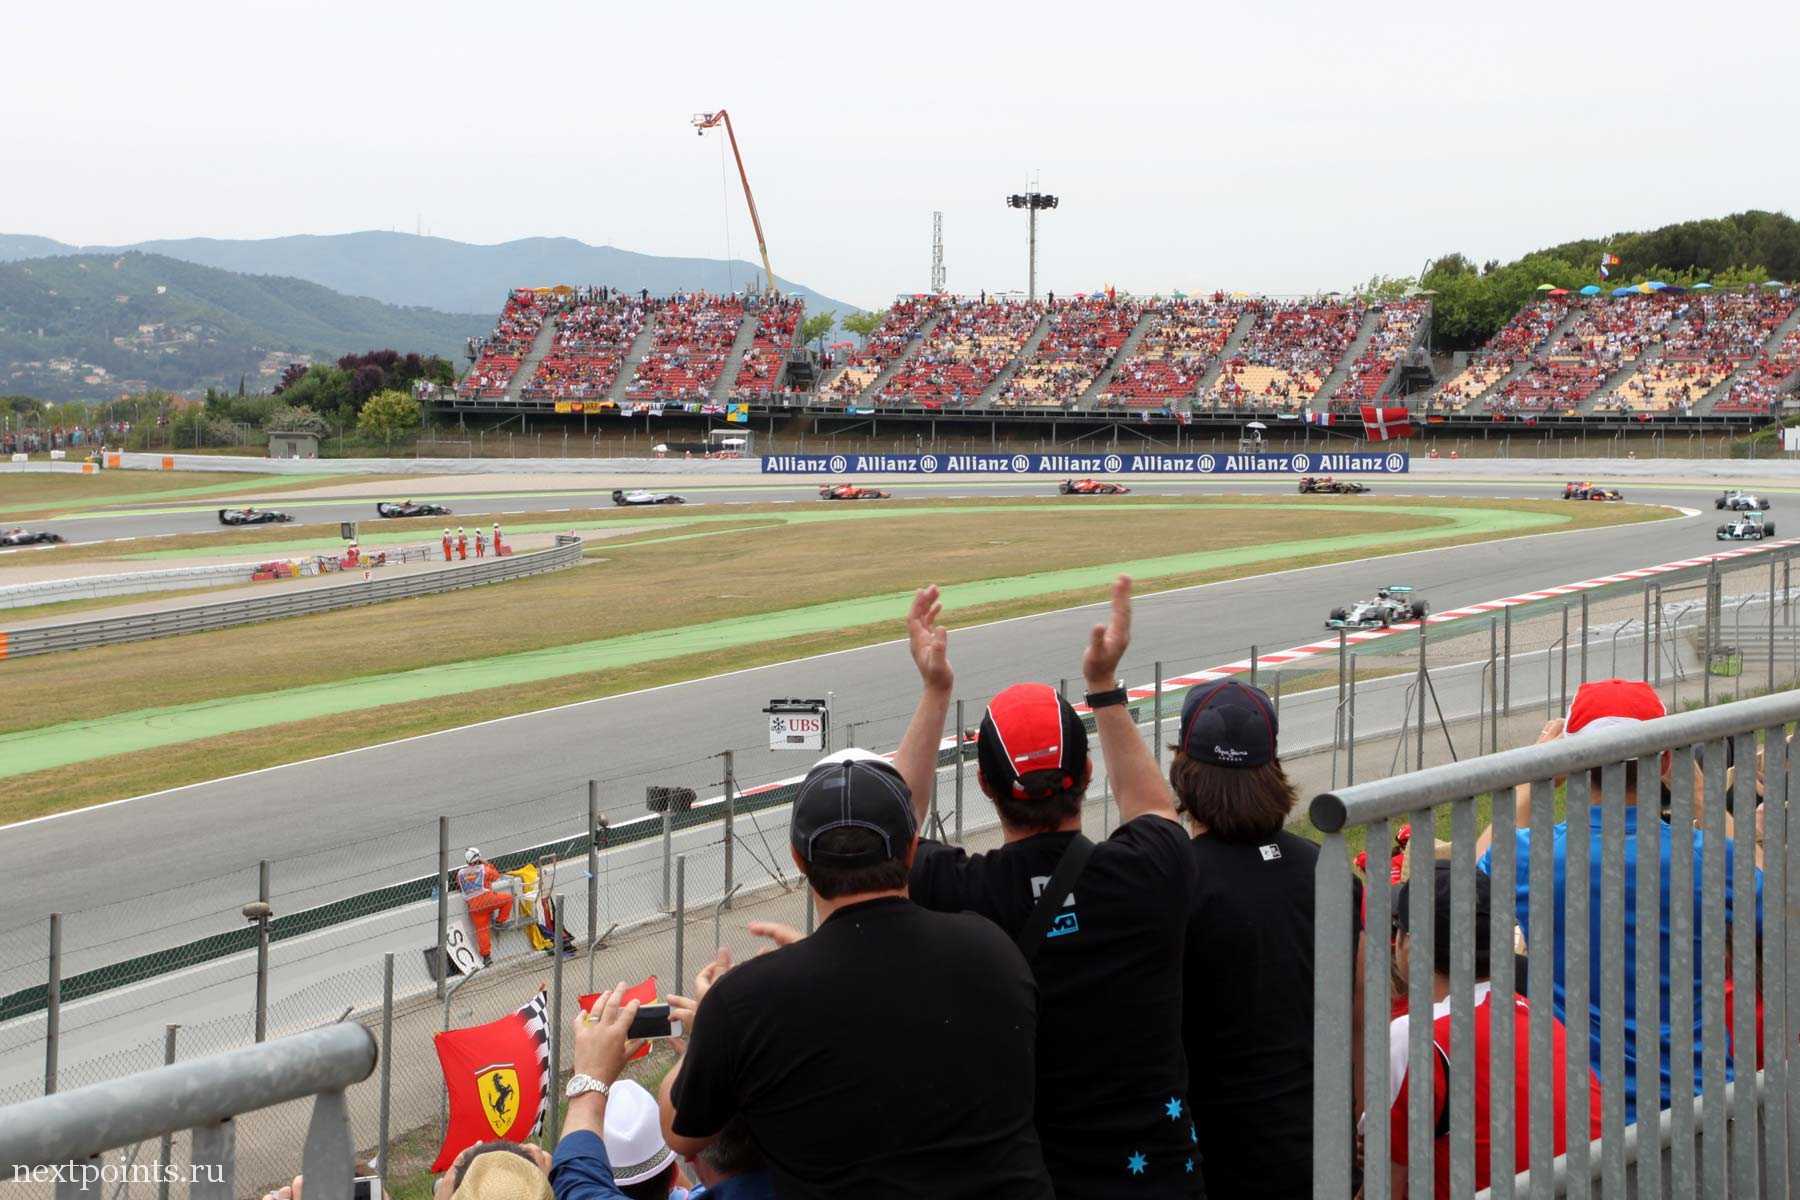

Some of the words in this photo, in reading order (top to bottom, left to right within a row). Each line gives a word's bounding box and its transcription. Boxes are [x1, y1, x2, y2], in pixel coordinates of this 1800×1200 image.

[766, 457, 826, 472] Allianz
[857, 457, 917, 472] Allianz
[947, 456, 1008, 472] Allianz
[1040, 456, 1101, 471] Allianz
[1132, 456, 1193, 471] Allianz
[1226, 456, 1288, 471] Allianz
[1320, 455, 1382, 470] Allianz
[789, 719, 819, 732] UBS
